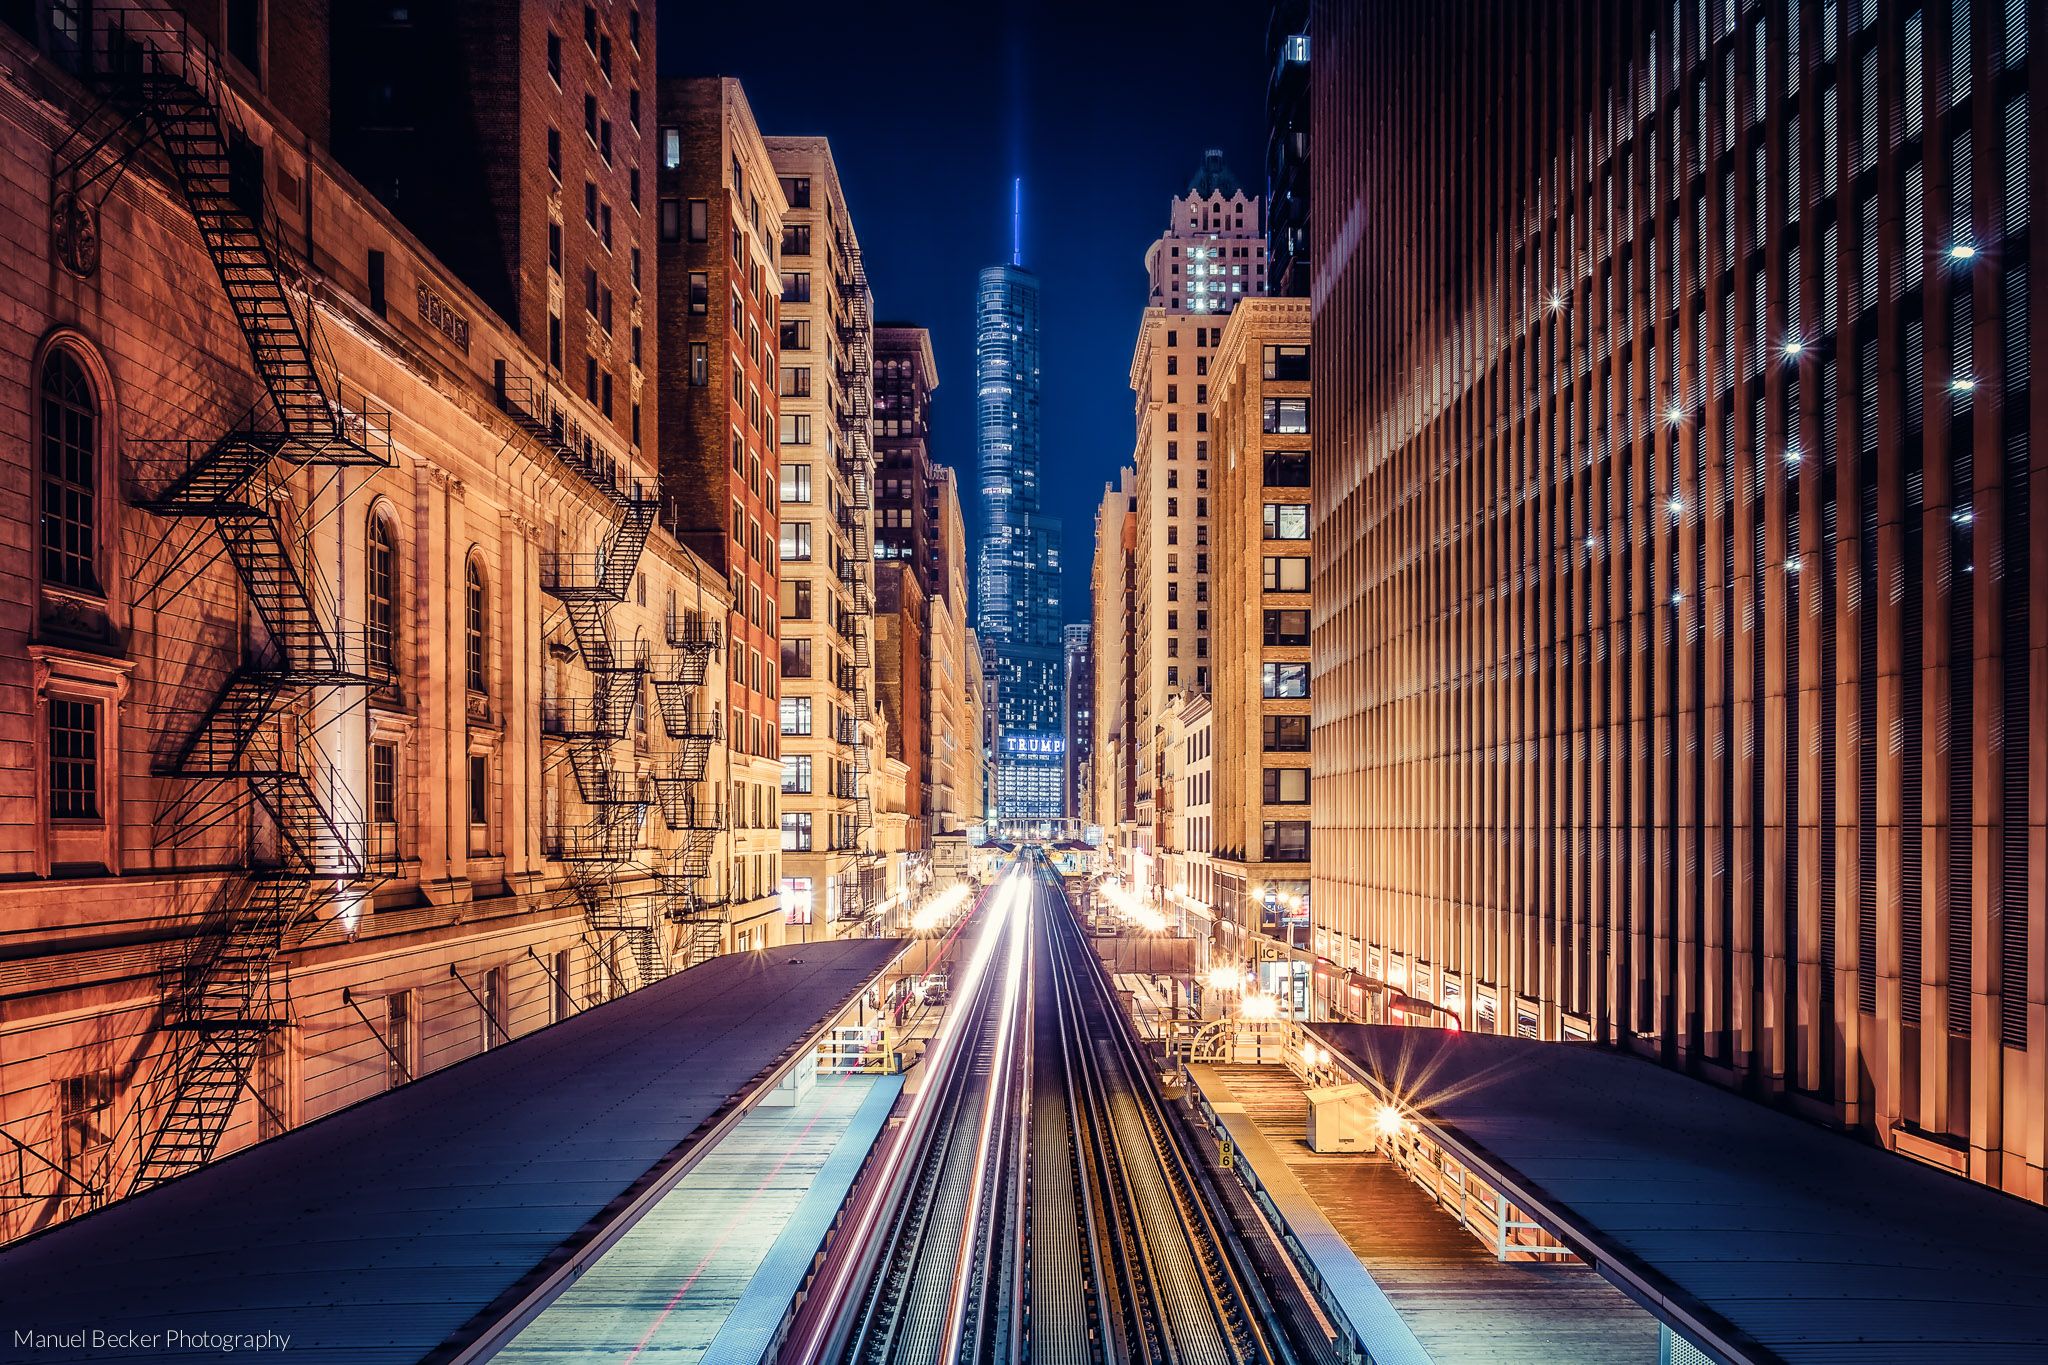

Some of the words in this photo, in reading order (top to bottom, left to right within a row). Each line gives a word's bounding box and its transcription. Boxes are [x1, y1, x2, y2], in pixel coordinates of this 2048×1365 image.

[1007, 738, 1061, 753] TRUMP
[1223, 1142, 1231, 1153] 8
[1222, 1155, 1231, 1166] 6
